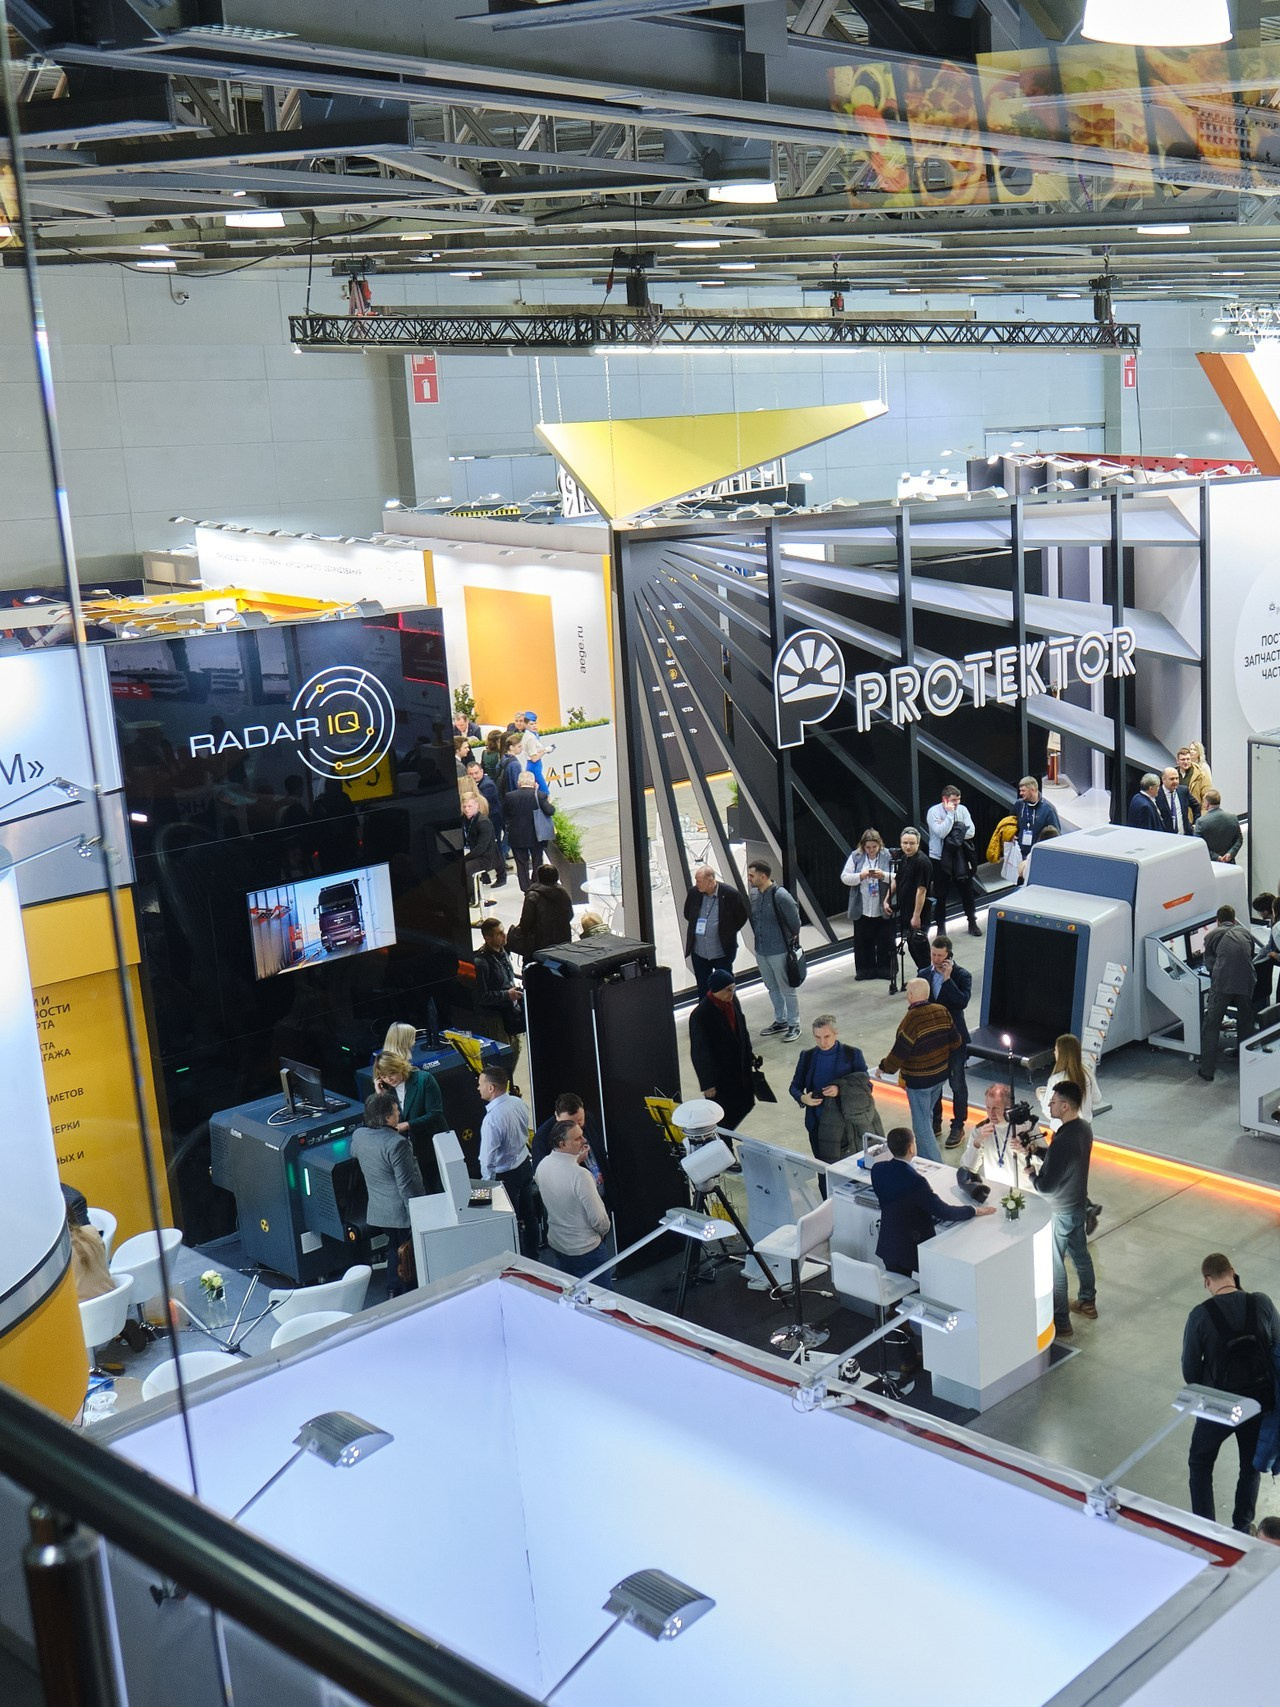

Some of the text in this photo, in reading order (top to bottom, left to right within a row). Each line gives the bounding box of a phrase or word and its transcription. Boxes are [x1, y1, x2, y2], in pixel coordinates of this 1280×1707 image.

[577, 625, 587, 674] aege.ru
[855, 626, 1137, 733] PROTEKTOR
[189, 710, 360, 758] RADAR IQ
[546, 759, 602, 788] АЕГЭ
[42, 1048, 72, 1062] ГАЖА
[47, 1087, 84, 1105] МЕТОВ
